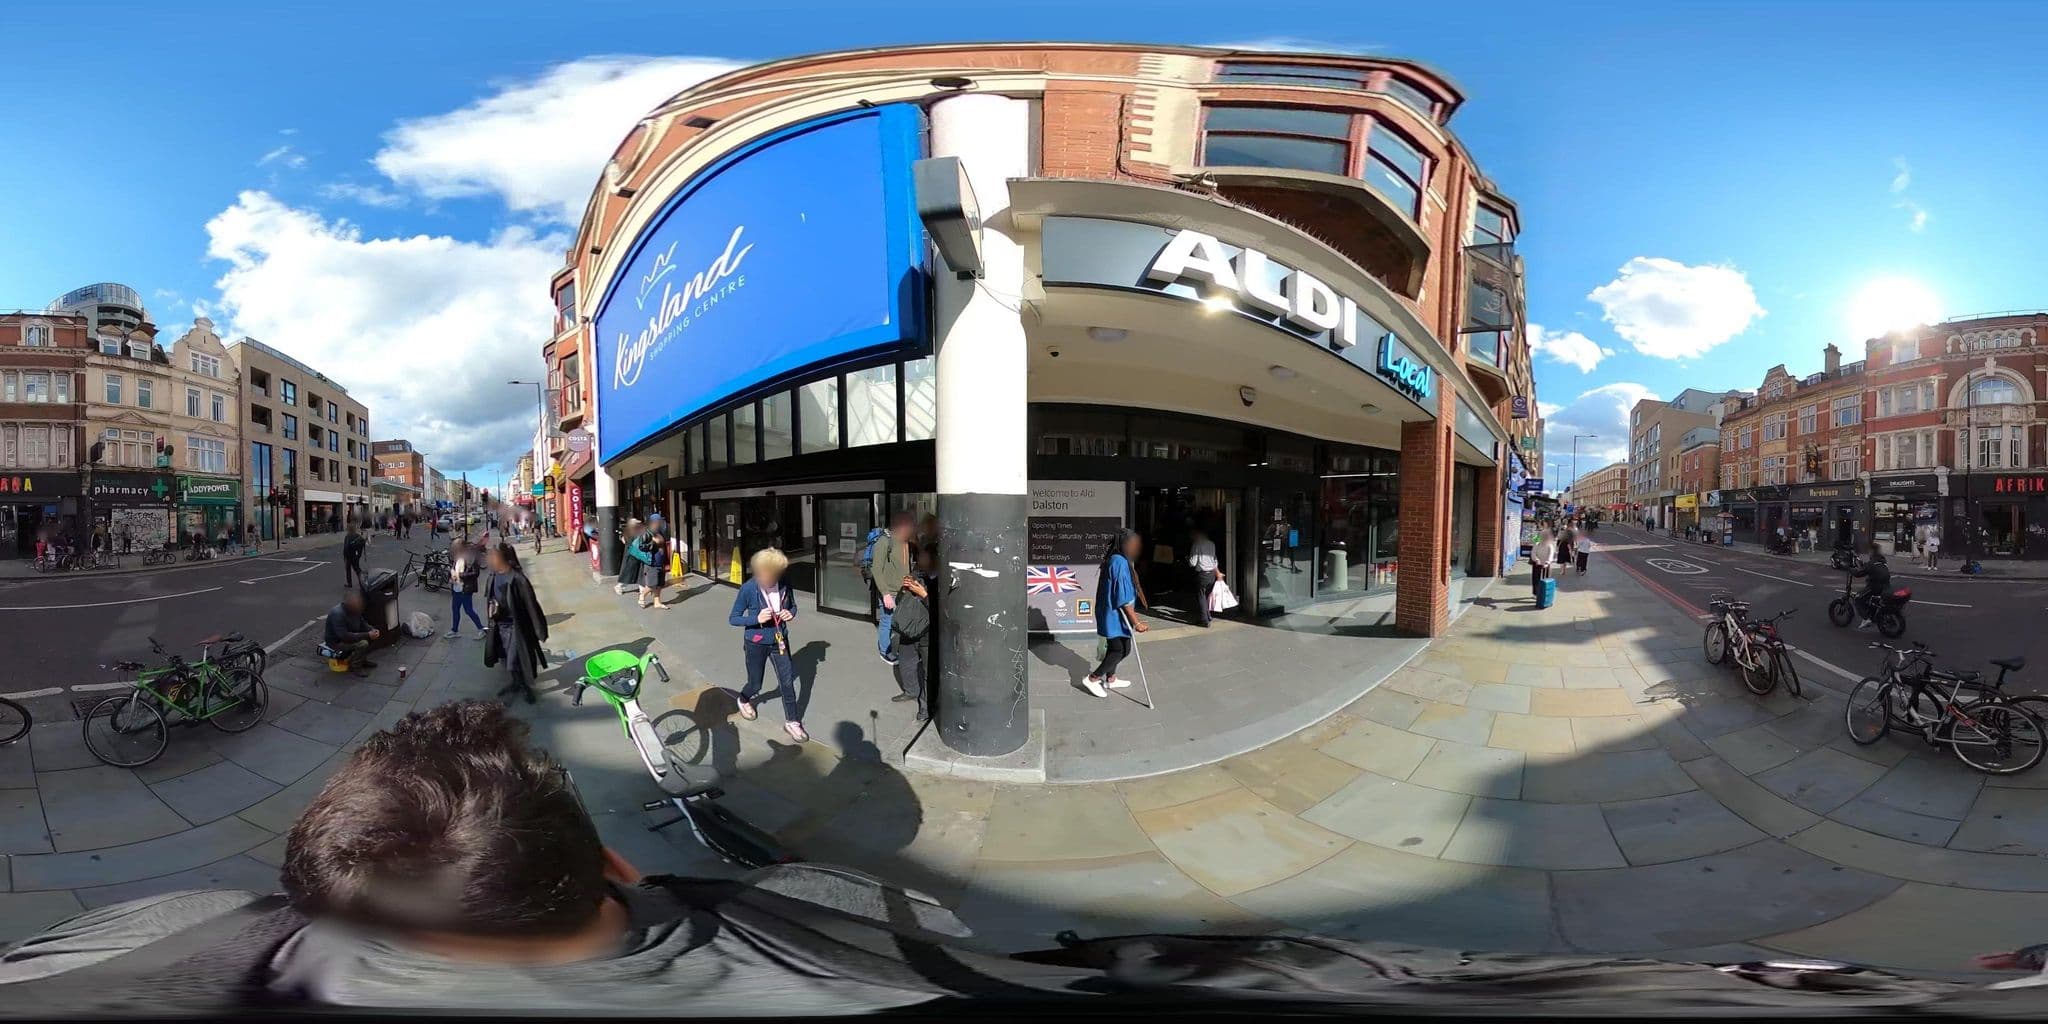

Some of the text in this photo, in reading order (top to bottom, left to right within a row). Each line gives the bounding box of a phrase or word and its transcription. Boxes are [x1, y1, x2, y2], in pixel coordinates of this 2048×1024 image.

[1147, 229, 1357, 349] ALDI
[614, 225, 755, 390] Kingsland
[649, 274, 746, 361] SHOPPING CENTRE
[1380, 331, 1432, 398] Local
[94, 484, 149, 497] pharmacy
[1996, 478, 2045, 492] AFRIK
[1032, 488, 1096, 498] Welcome to Aldi
[572, 488, 581, 525] COSTA
[1032, 500, 1069, 510] Dalston
[1032, 522, 1056, 530] Opening
[1032, 543, 1053, 551] Sunday
